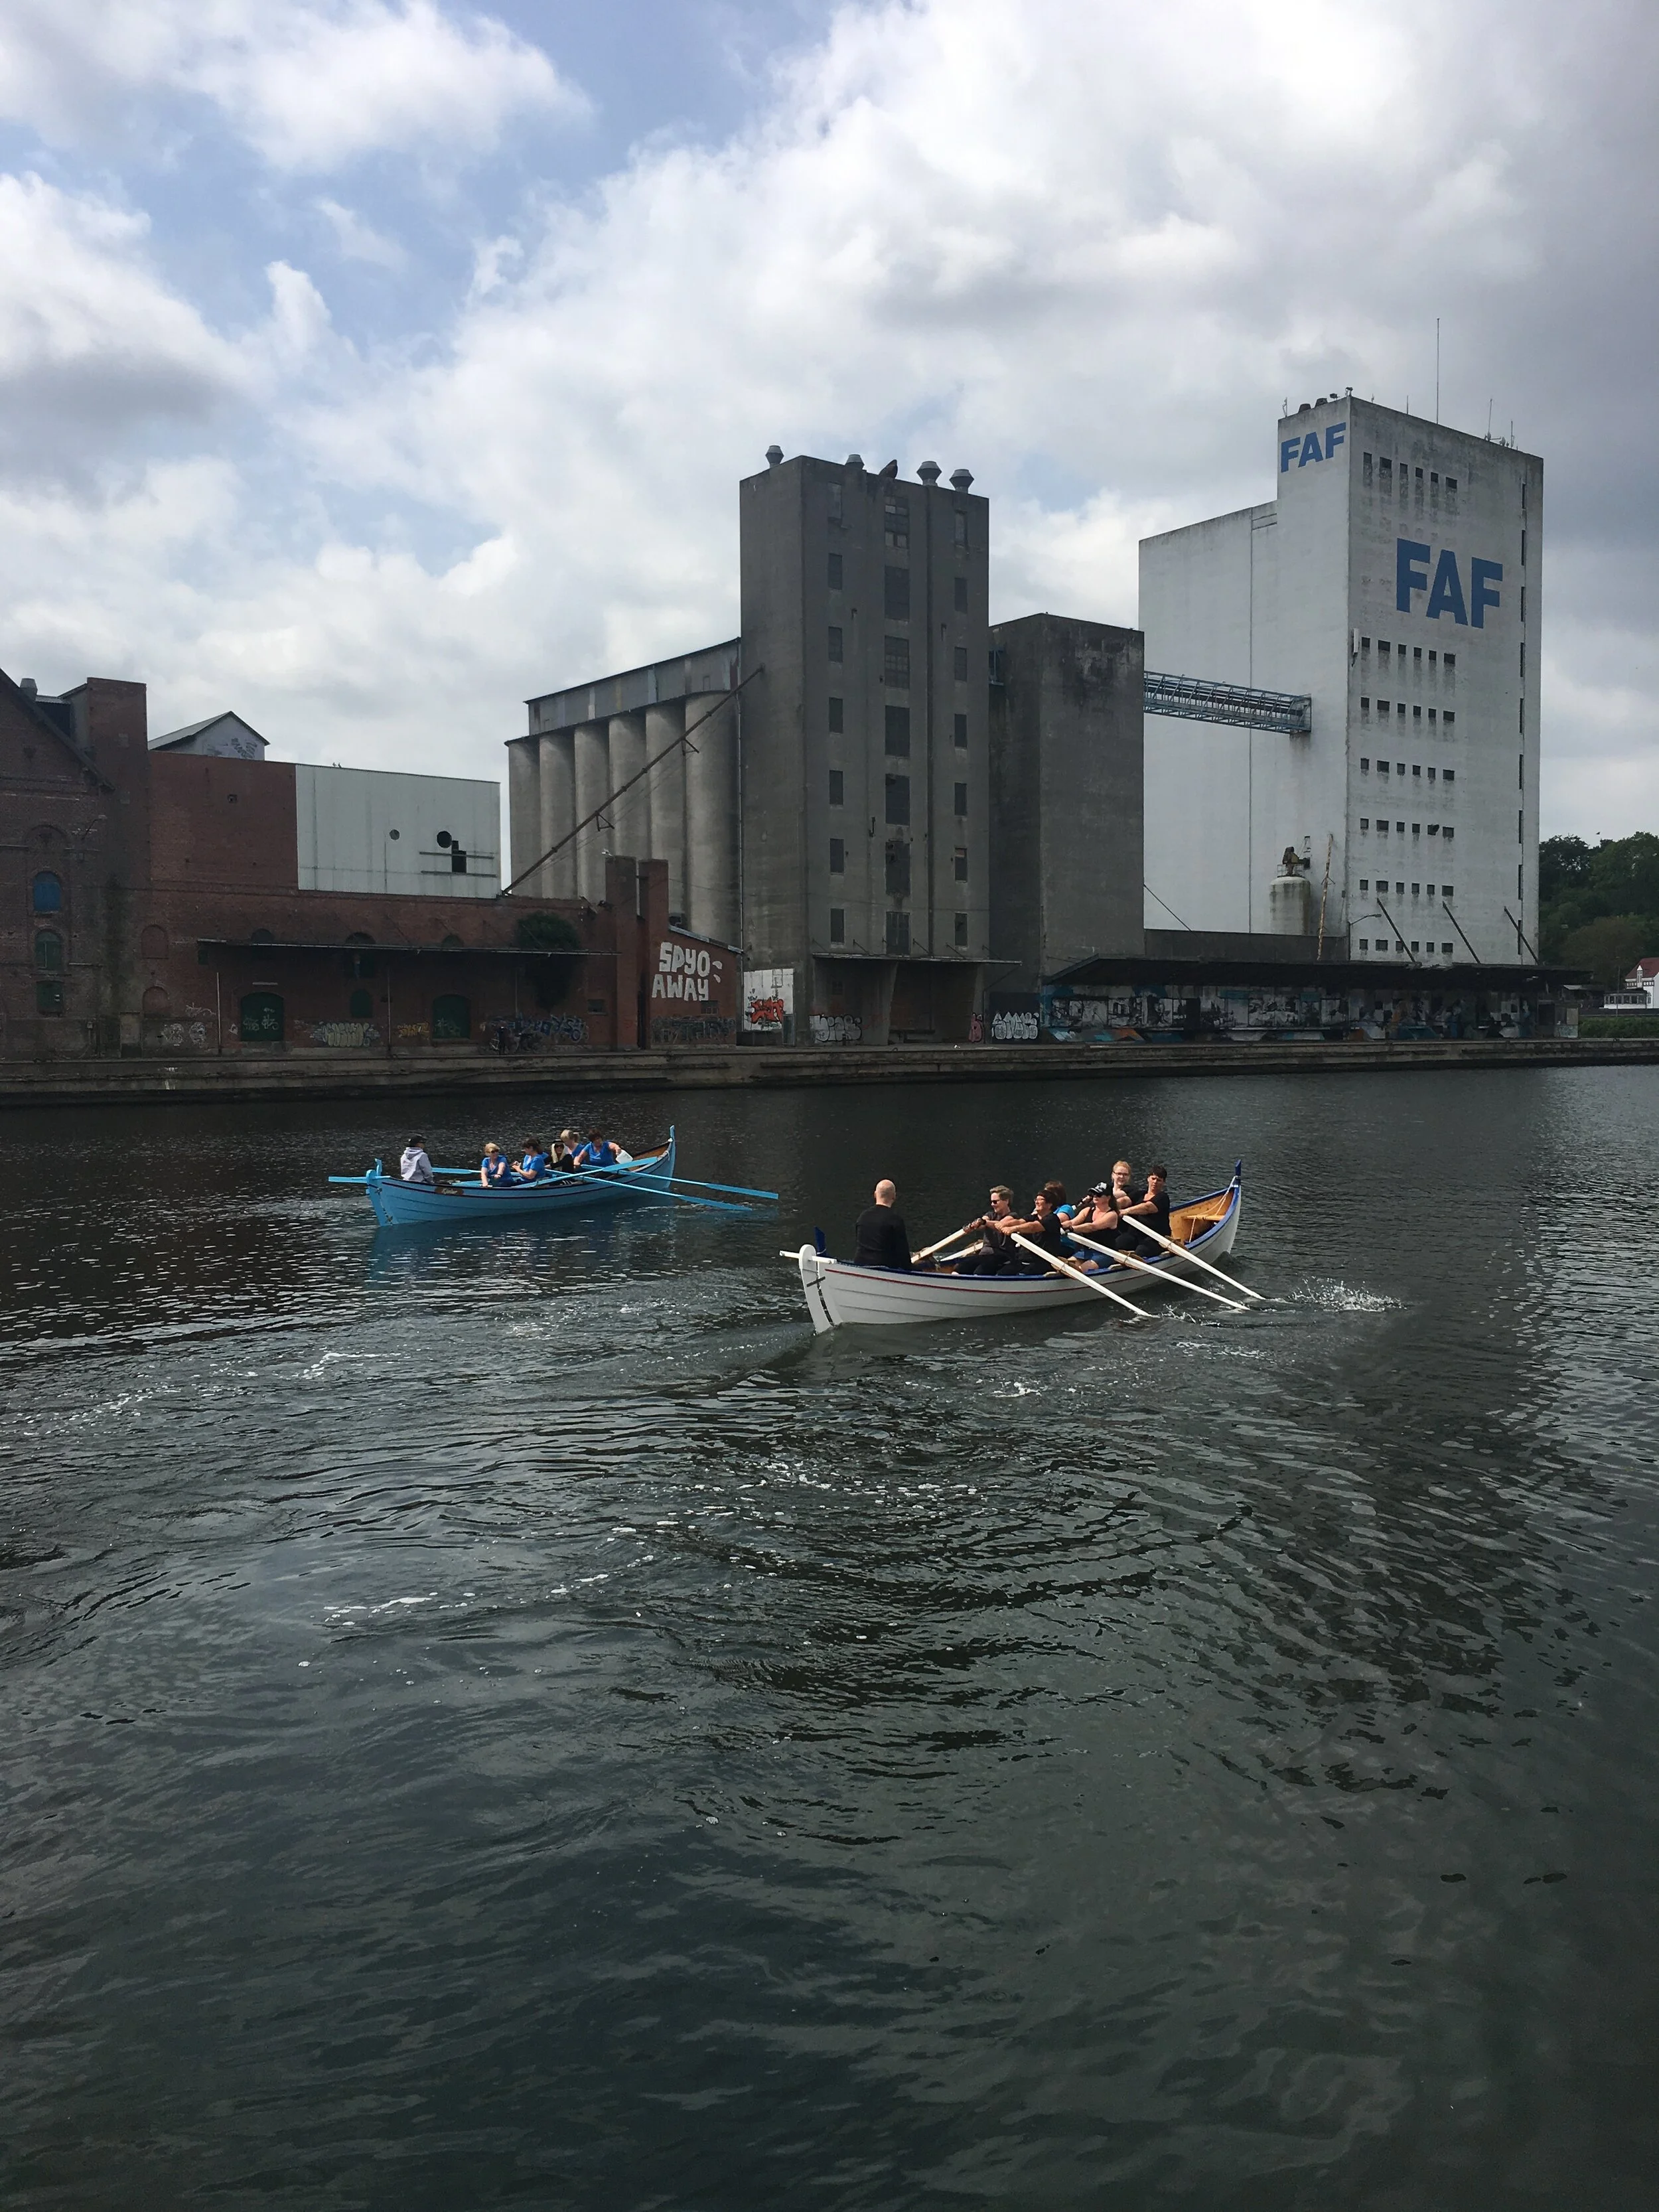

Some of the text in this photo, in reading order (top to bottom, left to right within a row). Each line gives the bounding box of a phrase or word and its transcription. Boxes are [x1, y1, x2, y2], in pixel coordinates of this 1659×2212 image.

[1281, 422, 1346, 473] FAF
[1397, 538, 1503, 628] FAF
[652, 974, 709, 1001] AWAY
